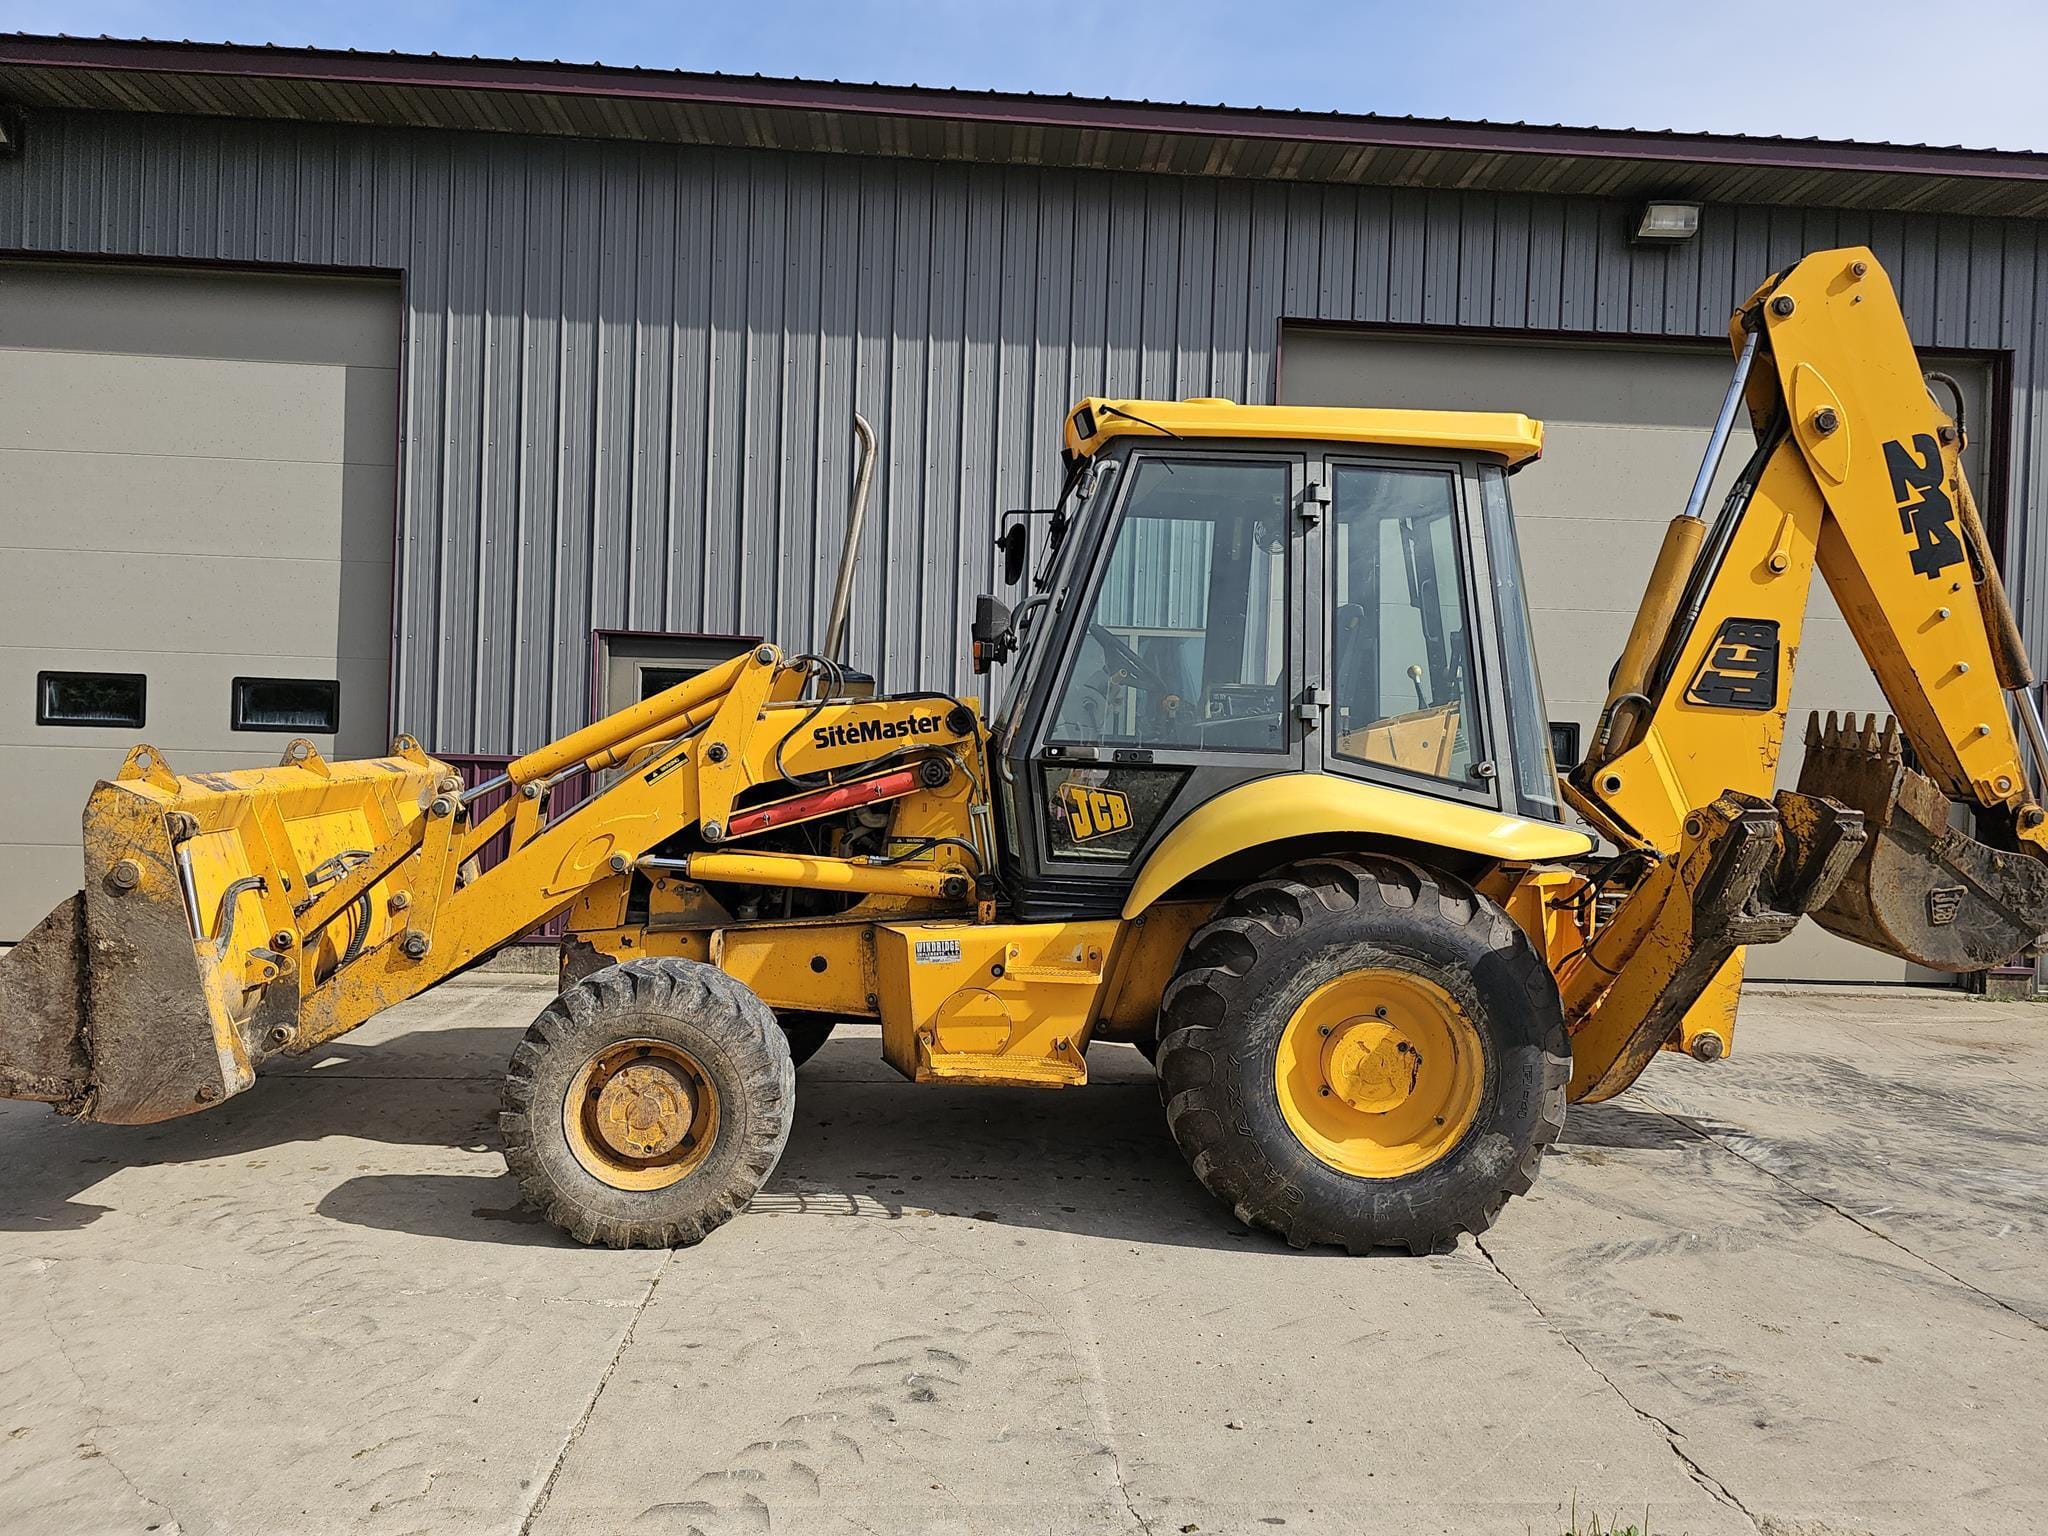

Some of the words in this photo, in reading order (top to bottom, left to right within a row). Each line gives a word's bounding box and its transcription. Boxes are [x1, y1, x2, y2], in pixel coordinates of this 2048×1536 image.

[1881, 433, 1965, 580] 214
[1692, 622, 1775, 708] JCB
[813, 714, 942, 749] SiteMaster
[1070, 788, 1128, 839] JCB
[916, 940, 961, 953] WINDRIDGE
